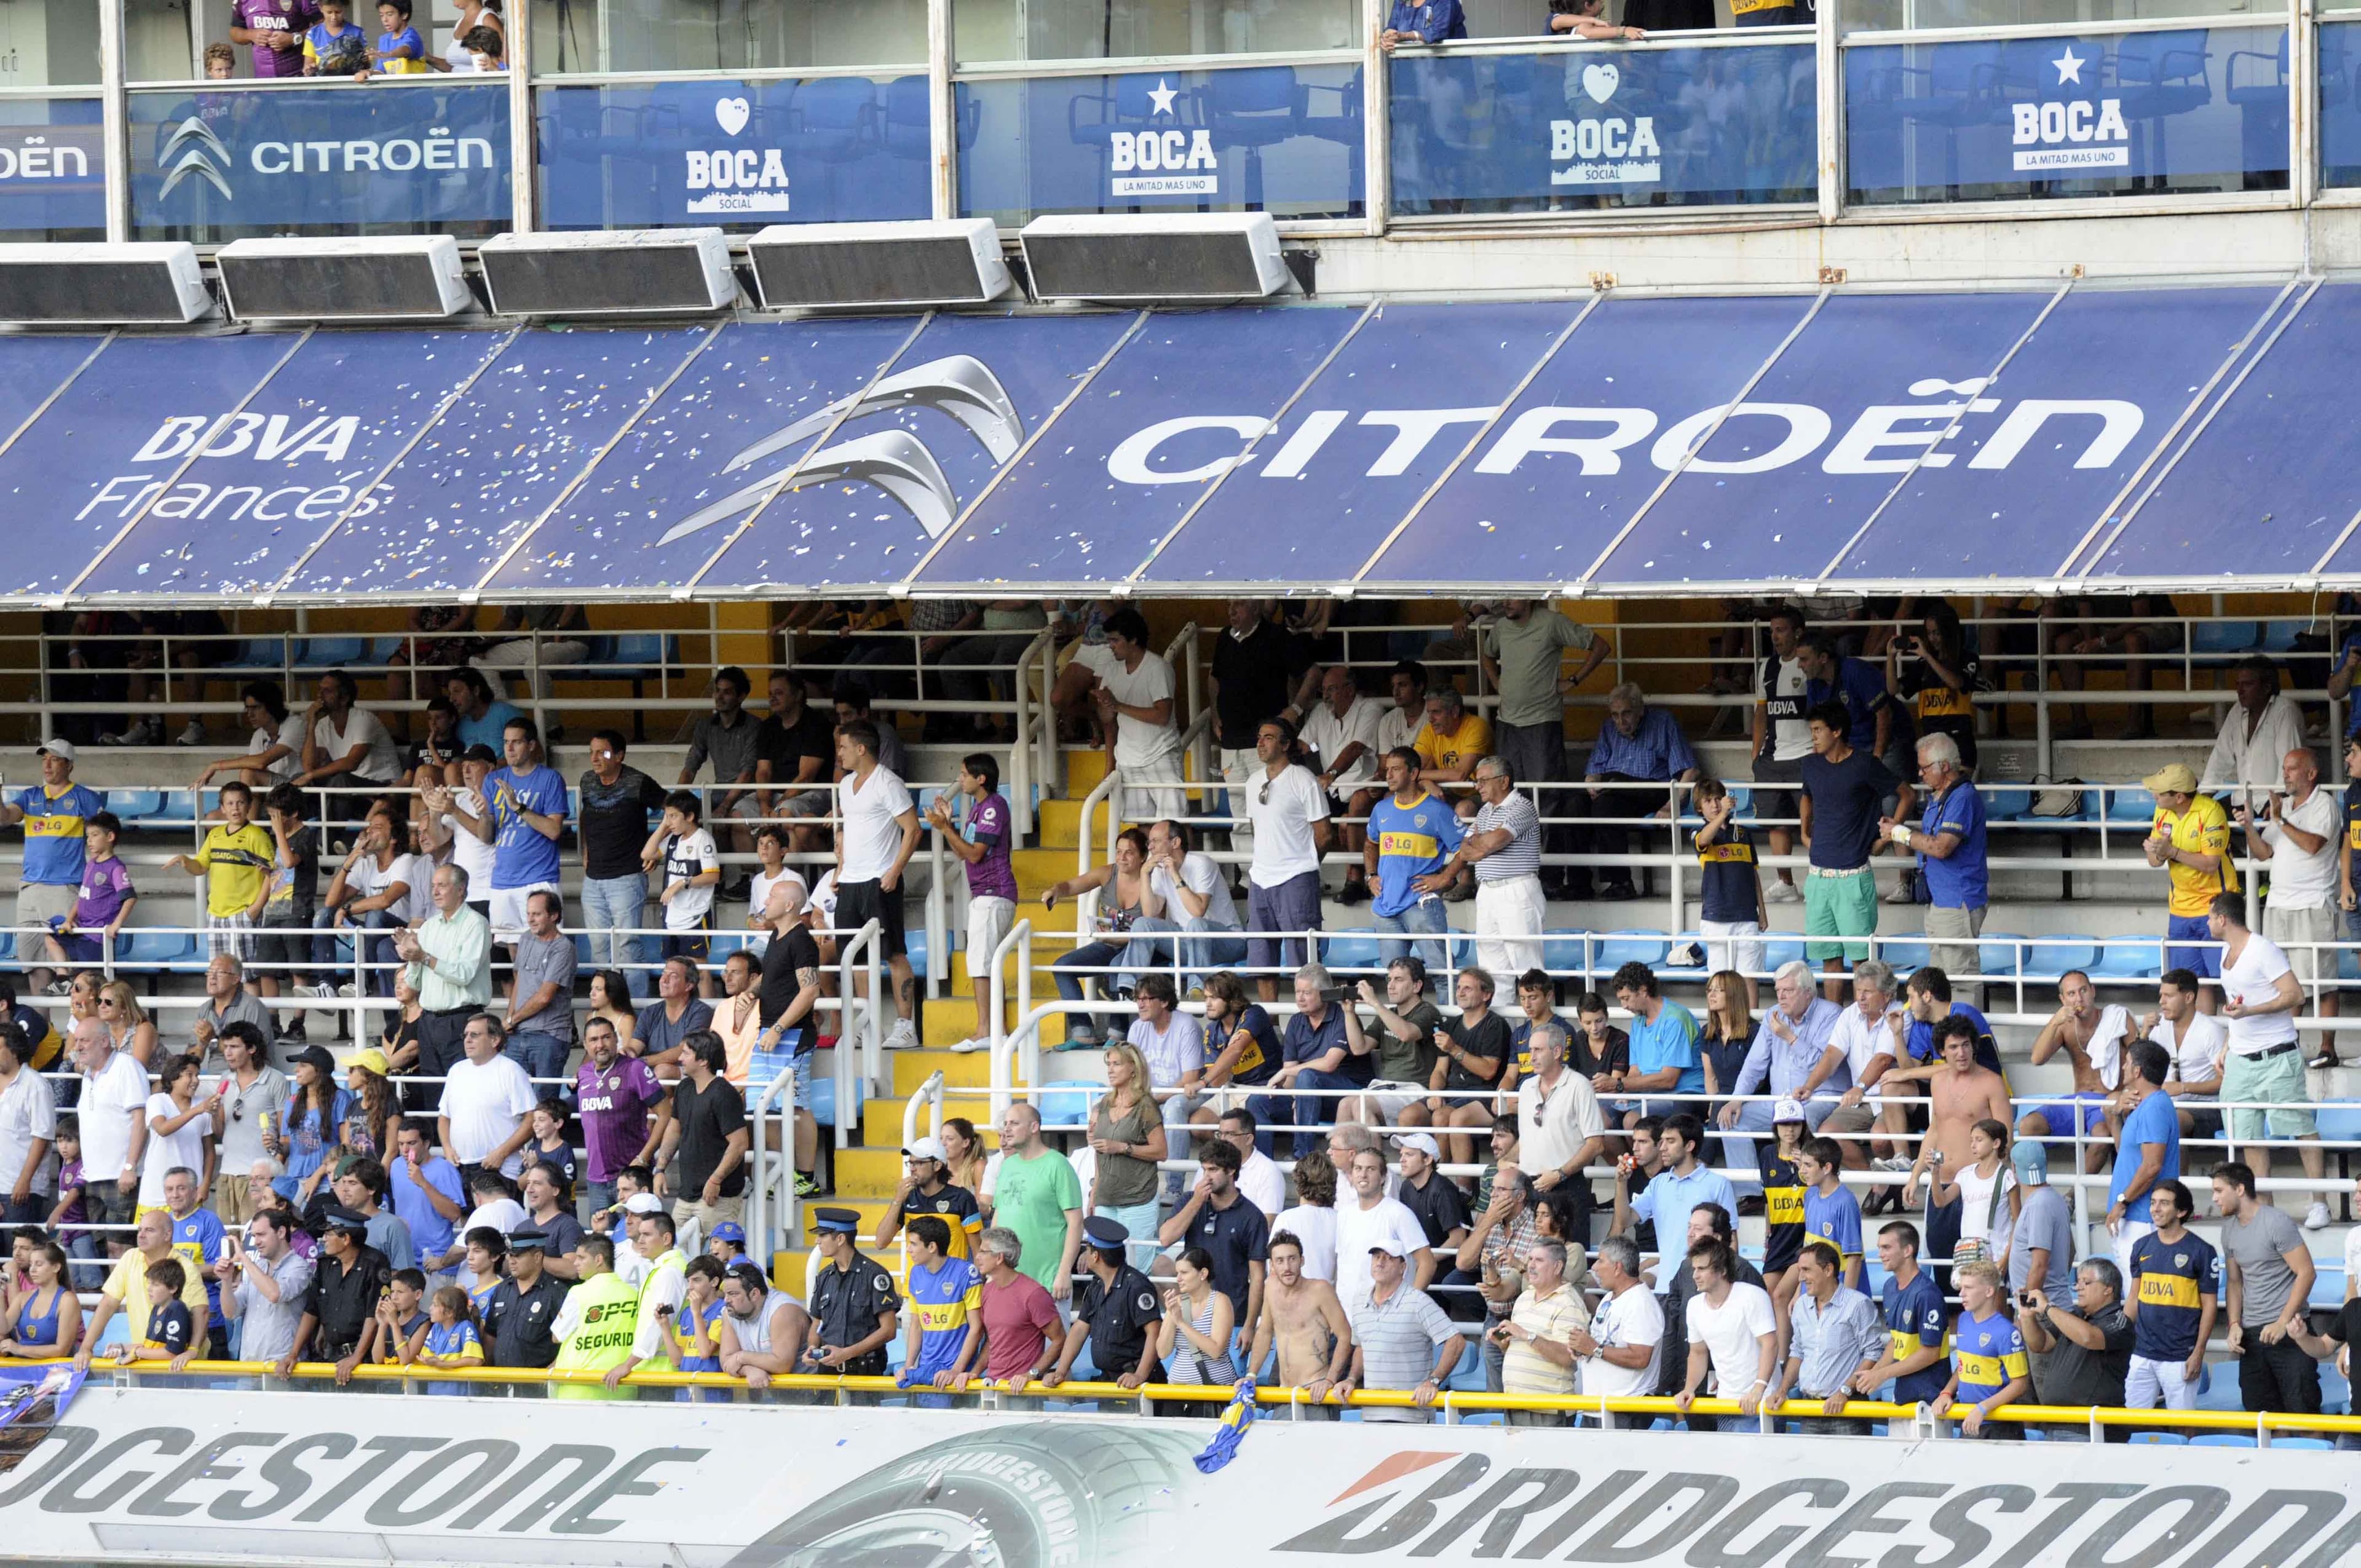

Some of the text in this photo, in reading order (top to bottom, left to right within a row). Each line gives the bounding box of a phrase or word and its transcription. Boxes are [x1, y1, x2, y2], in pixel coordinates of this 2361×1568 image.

[253, 16, 290, 30] BBVA
[2012, 98, 2128, 145] BOCA
[1550, 117, 1660, 160] BOCA
[1111, 130, 1217, 171] BOCA
[2027, 152, 2115, 165] LA MITAD MAS UNO
[686, 149, 789, 189] BOCA
[1585, 169, 1621, 180] SOCIAL
[1124, 180, 1205, 191] LA MITAD MAS UNO
[719, 198, 753, 209] SOCIAL
[131, 411, 361, 462] BBVA
[74, 470, 395, 521] Francés
[46, 821, 61, 830] LG
[1396, 839, 1412, 849] LG
[581, 1096, 613, 1112] BBVA
[1773, 1198, 1804, 1210] BBVA
[2143, 1280, 2174, 1297] BBVA
[1923, 1323, 1940, 1331] TOTAL
[1966, 1363, 1980, 1375] LG
[1269, 1452, 2361, 1568] BRIDGESTON
